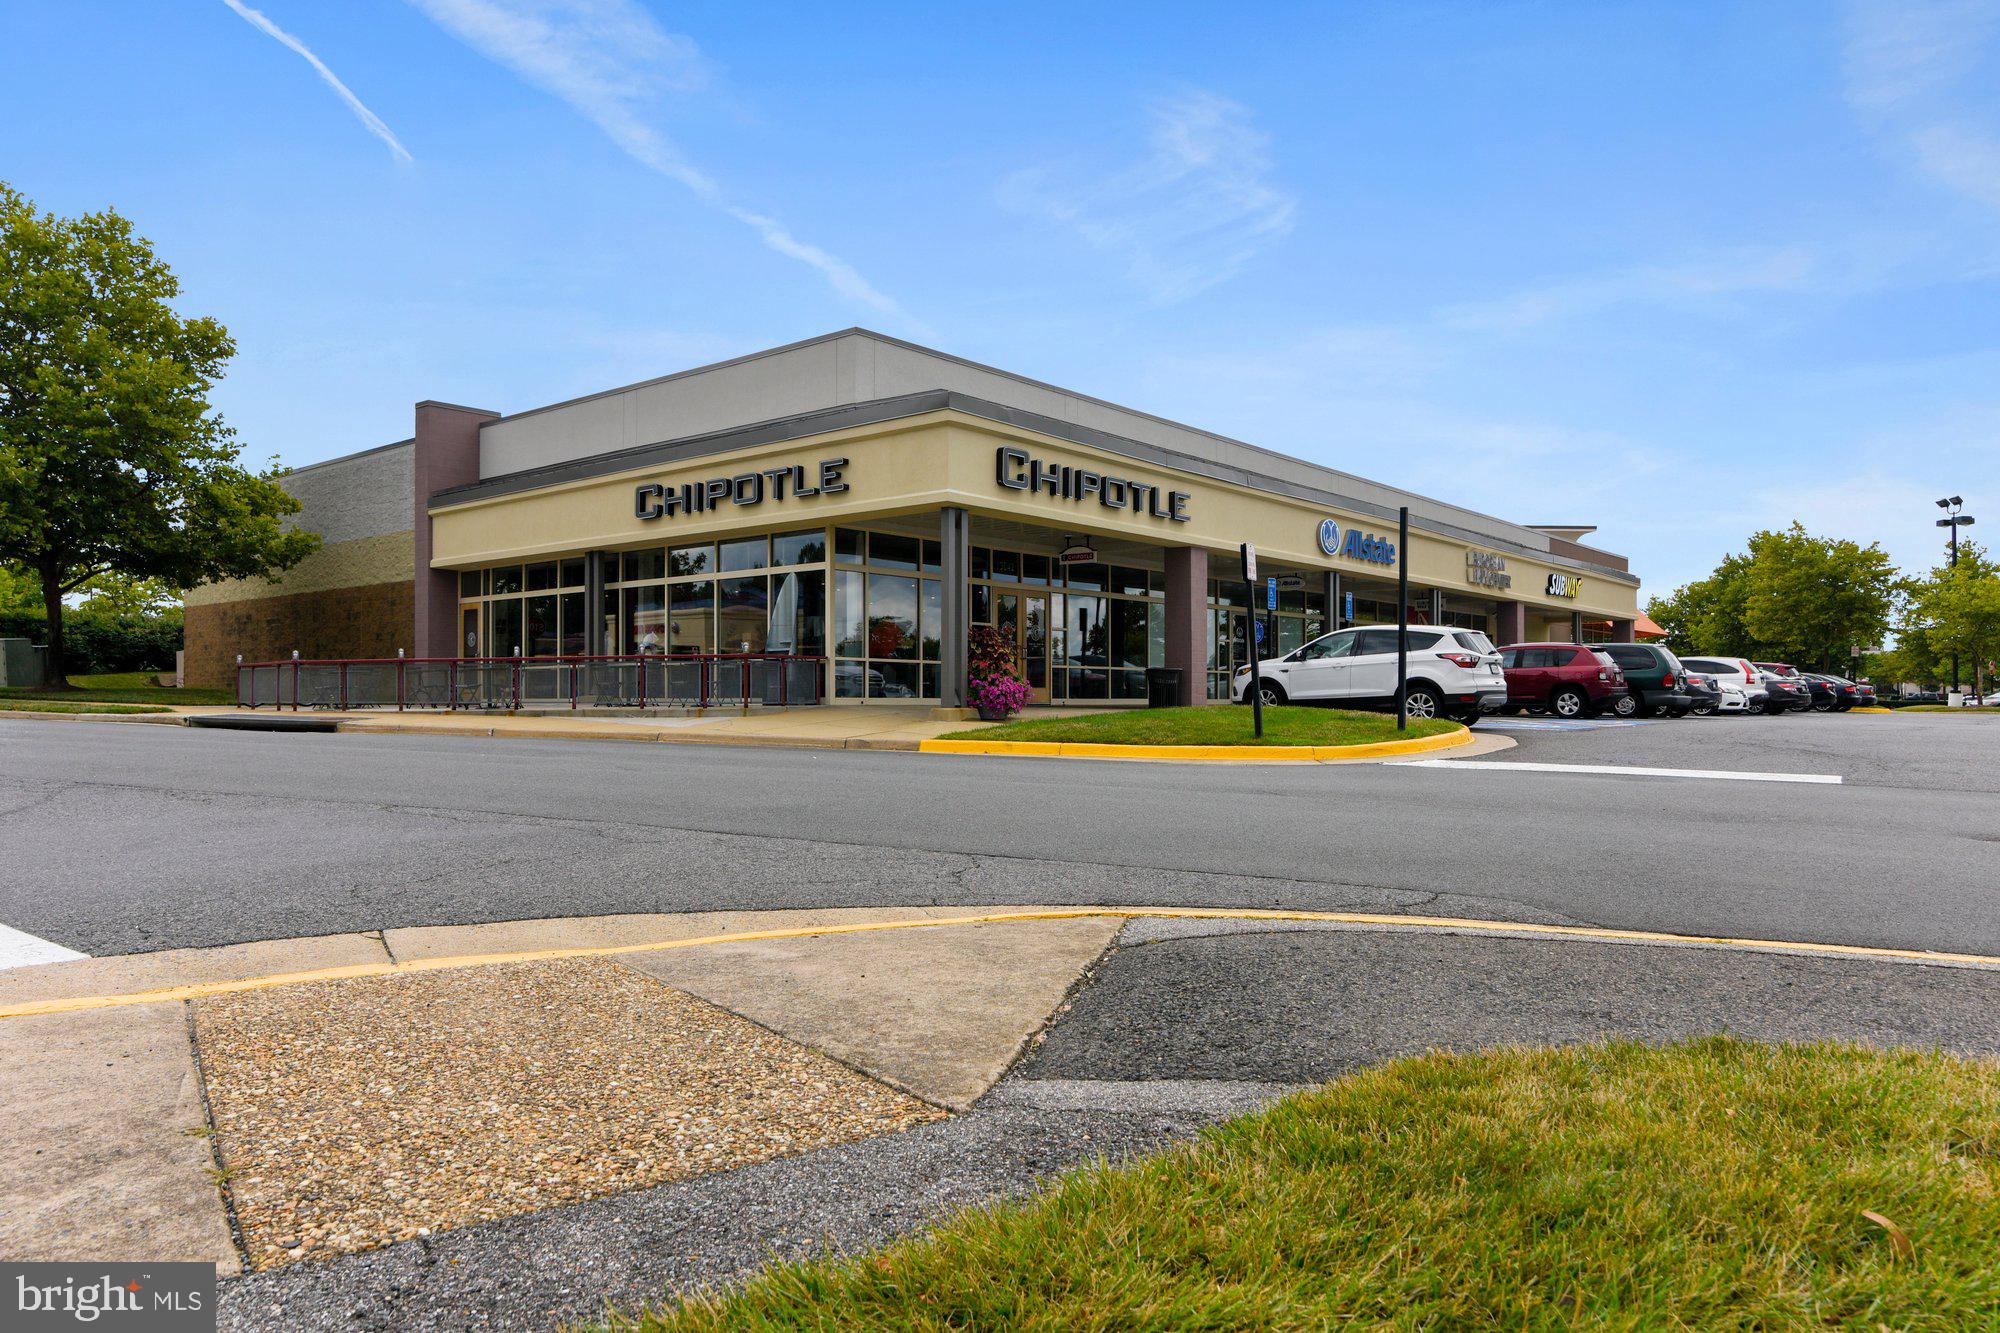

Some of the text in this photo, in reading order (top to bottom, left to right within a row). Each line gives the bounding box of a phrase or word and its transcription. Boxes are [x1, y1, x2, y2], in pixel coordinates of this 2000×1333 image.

[635, 457, 849, 520] CHIPOTLE
[996, 446, 1191, 522] CHIPOTLE
[1341, 529, 1396, 565] Allstate
[1546, 573, 1583, 600] SUBWAY
